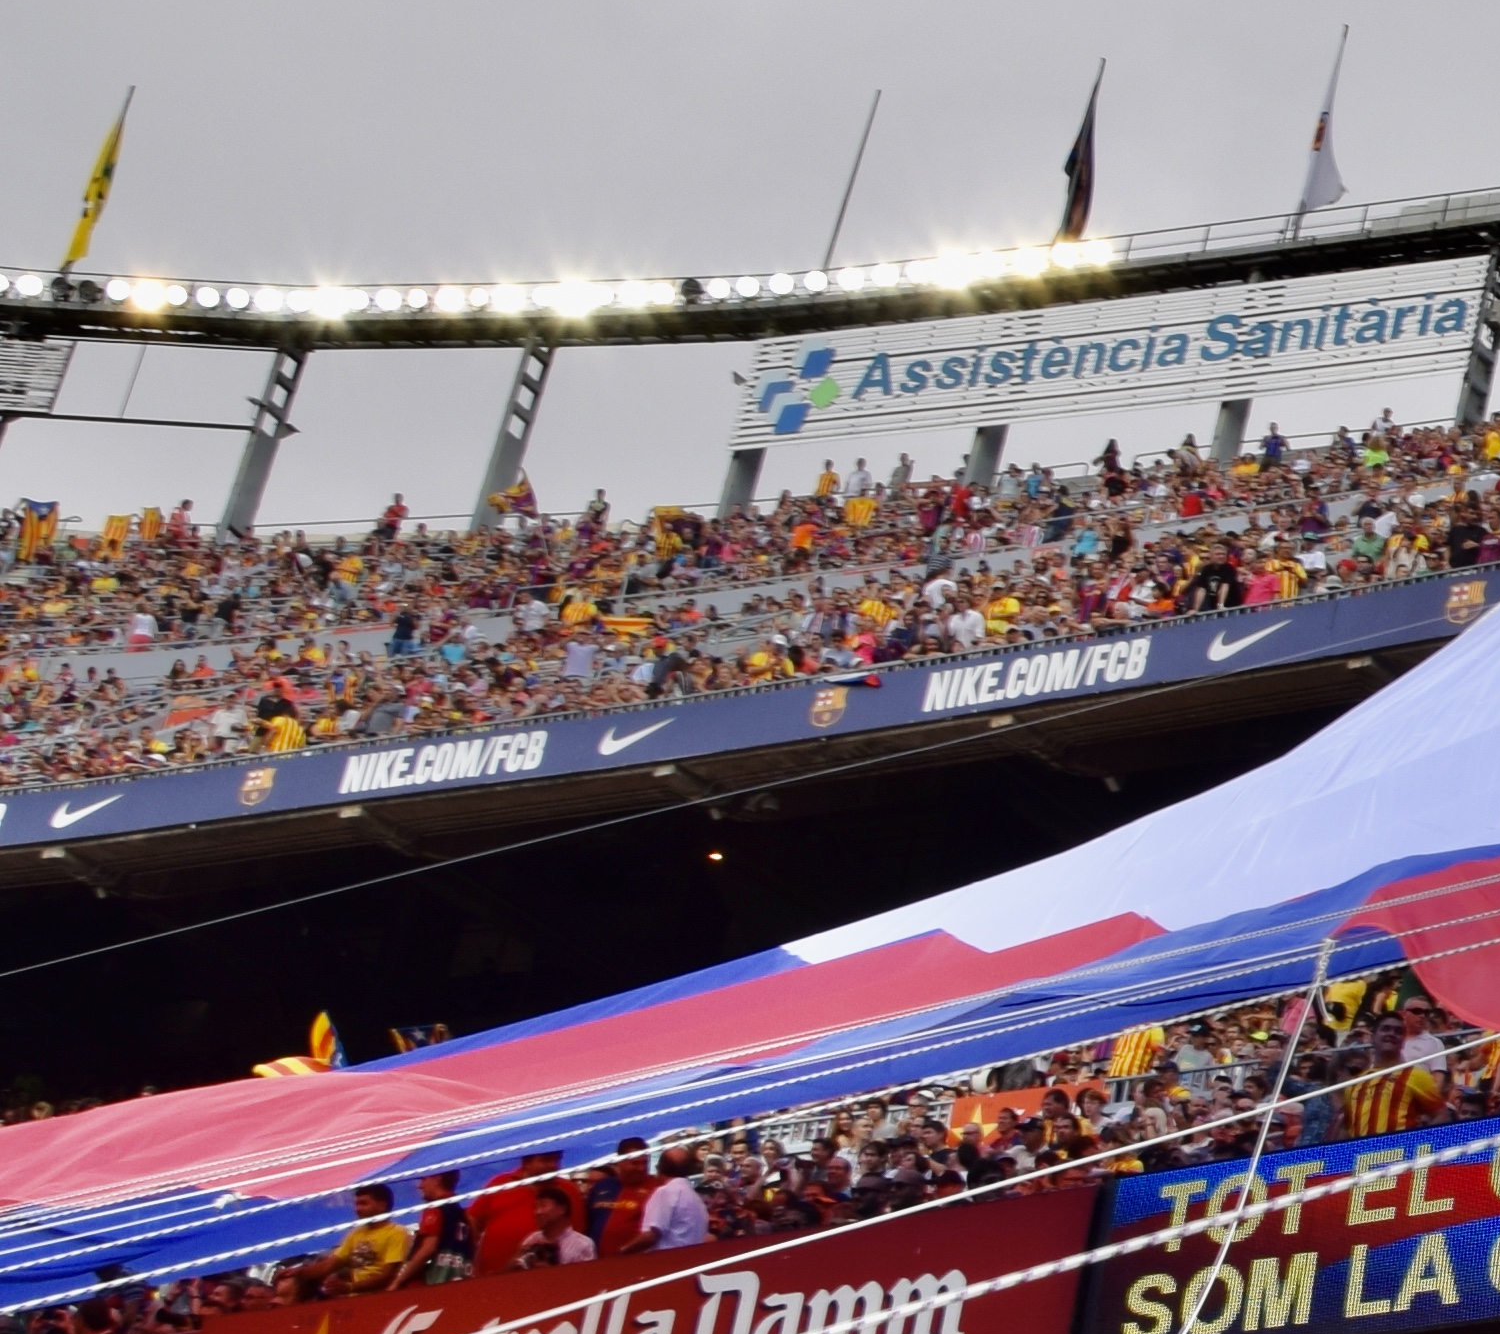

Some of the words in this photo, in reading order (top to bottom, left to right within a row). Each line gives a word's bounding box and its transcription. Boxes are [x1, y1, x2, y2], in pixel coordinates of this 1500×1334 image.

[852, 323, 1187, 400] Assistència
[1200, 293, 1469, 362] Sanitària
[921, 637, 1151, 712] NIKE.COM/FCB
[338, 730, 548, 795] NIKE.COM/FCB
[1160, 1167, 1326, 1252] TOT
[1346, 1147, 1455, 1235] EL
[1343, 1237, 1462, 1320] LA
